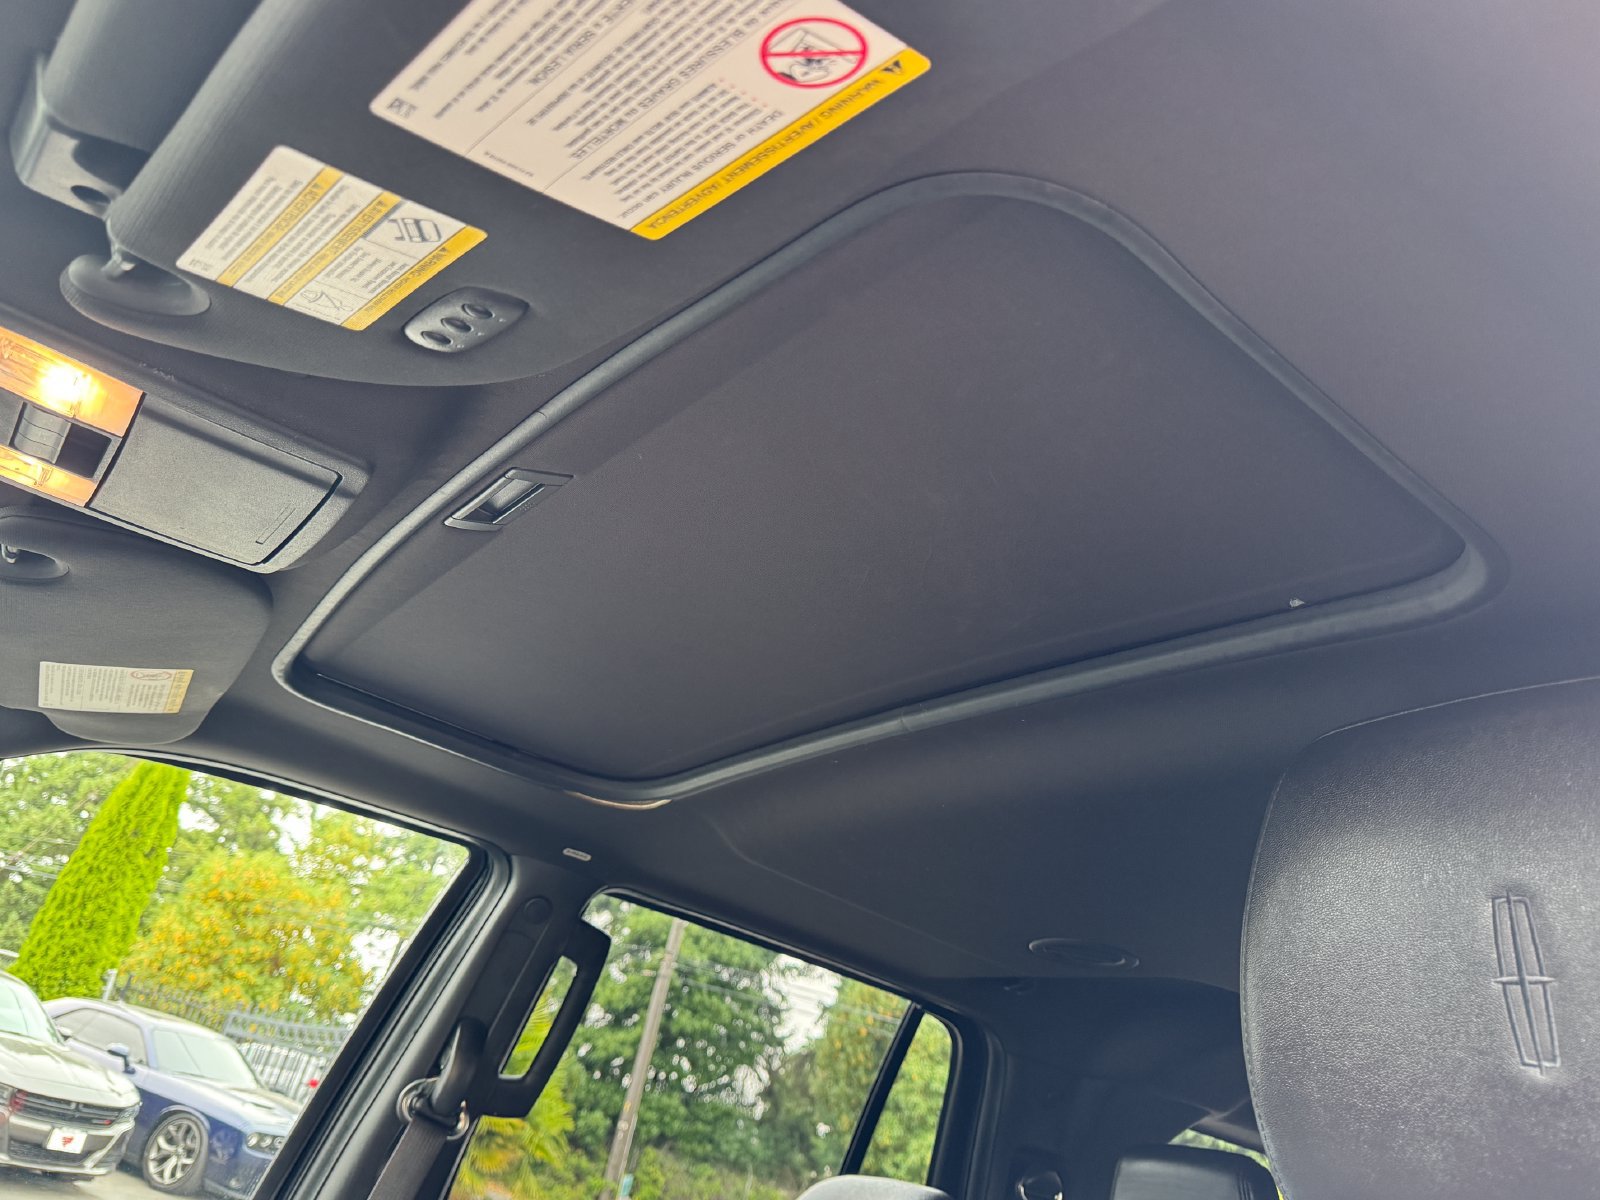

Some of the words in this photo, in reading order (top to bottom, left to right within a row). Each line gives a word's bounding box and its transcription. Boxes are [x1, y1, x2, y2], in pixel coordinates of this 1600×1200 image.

[676, 29, 747, 80] BLESSURES
[635, 77, 683, 110] GRAVES
[817, 78, 884, 119] WARNING
[743, 109, 784, 135] DEATH
[689, 141, 737, 172] SERIOUS
[717, 120, 818, 183] AVERTISSEMENT
[657, 170, 694, 193] INJURY
